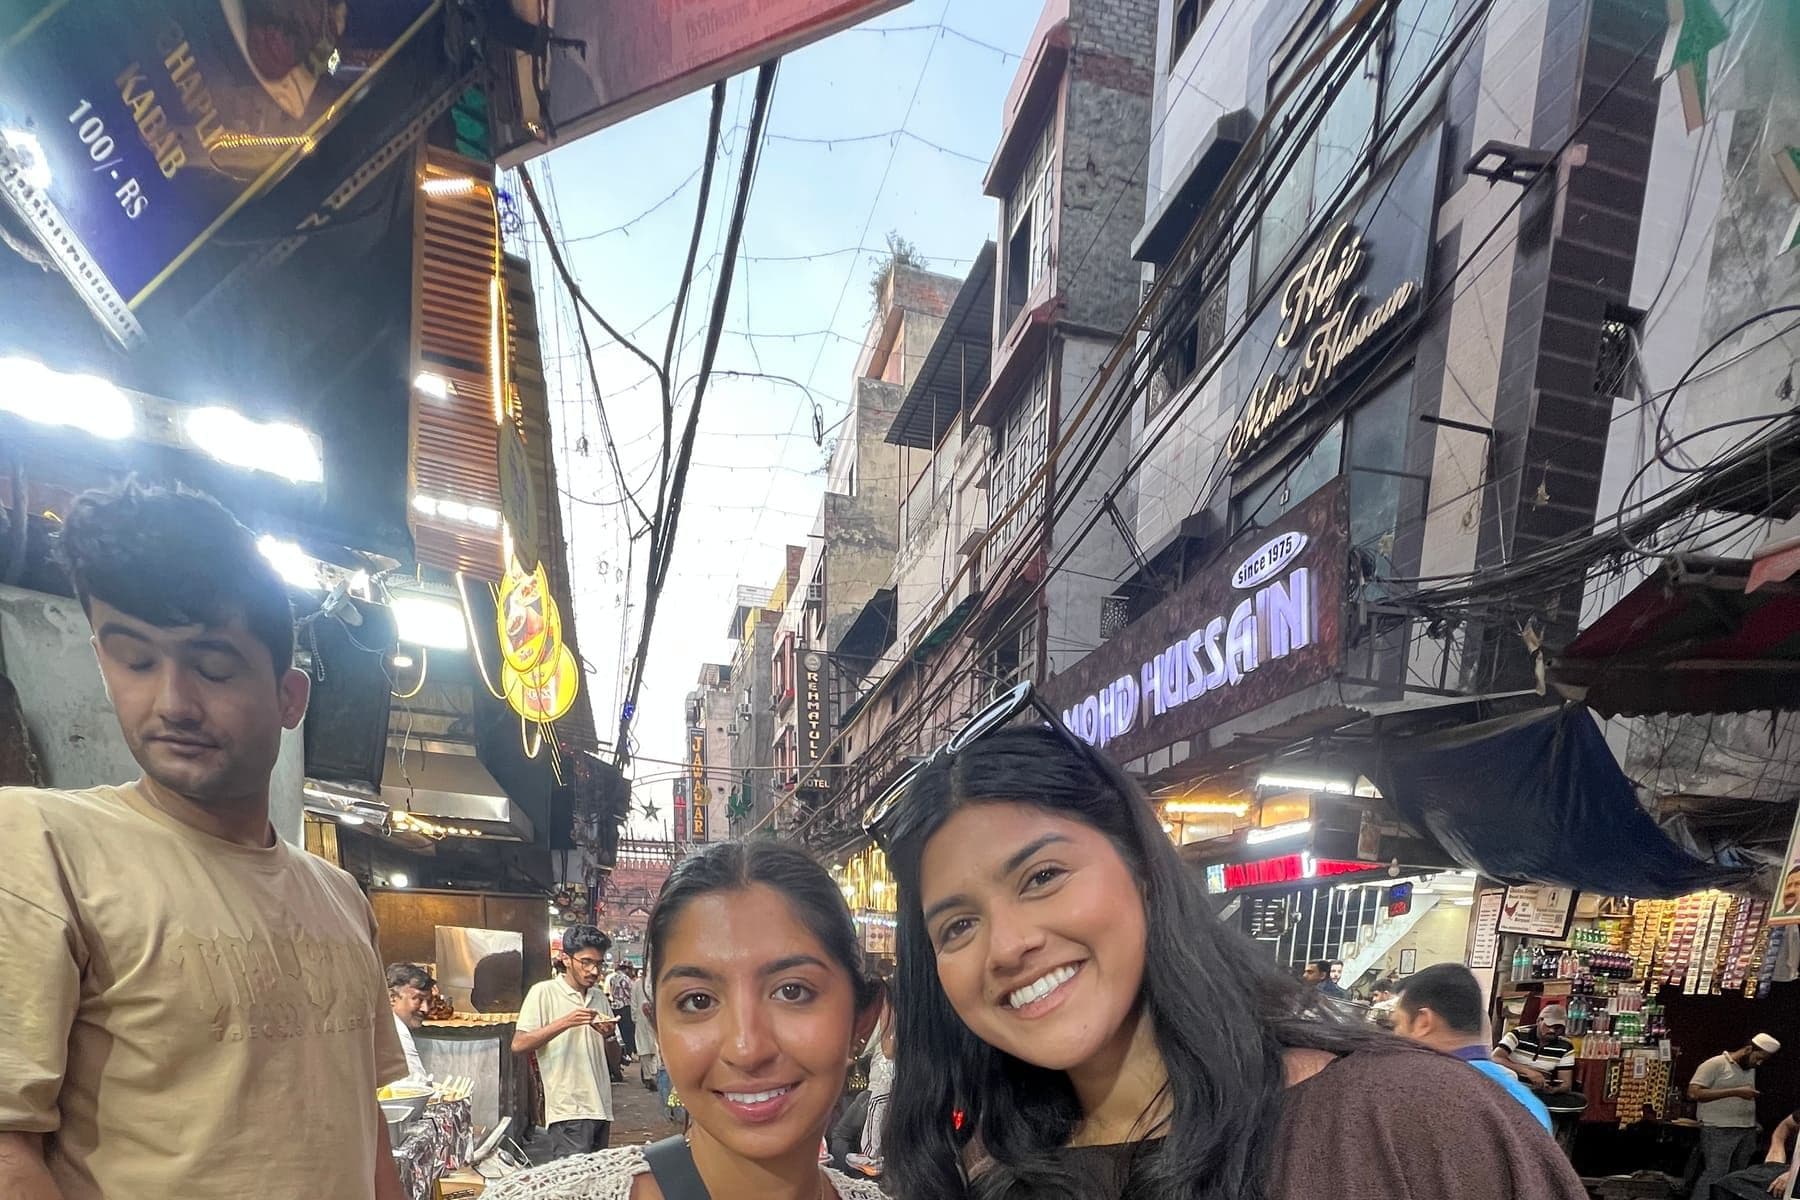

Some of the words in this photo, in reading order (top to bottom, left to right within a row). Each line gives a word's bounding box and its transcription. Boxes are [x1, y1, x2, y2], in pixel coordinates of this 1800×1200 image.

[68, 98, 123, 180] 100/-
[114, 179, 149, 220] RS
[115, 62, 189, 180] KABAB
[1277, 221, 1362, 349] Haji
[1303, 280, 1415, 396] Hussain
[1238, 558, 1266, 585] since
[1267, 535, 1293, 566] 1975
[1063, 674, 1139, 749] MOHD
[1141, 567, 1312, 728] HUSSAIN
